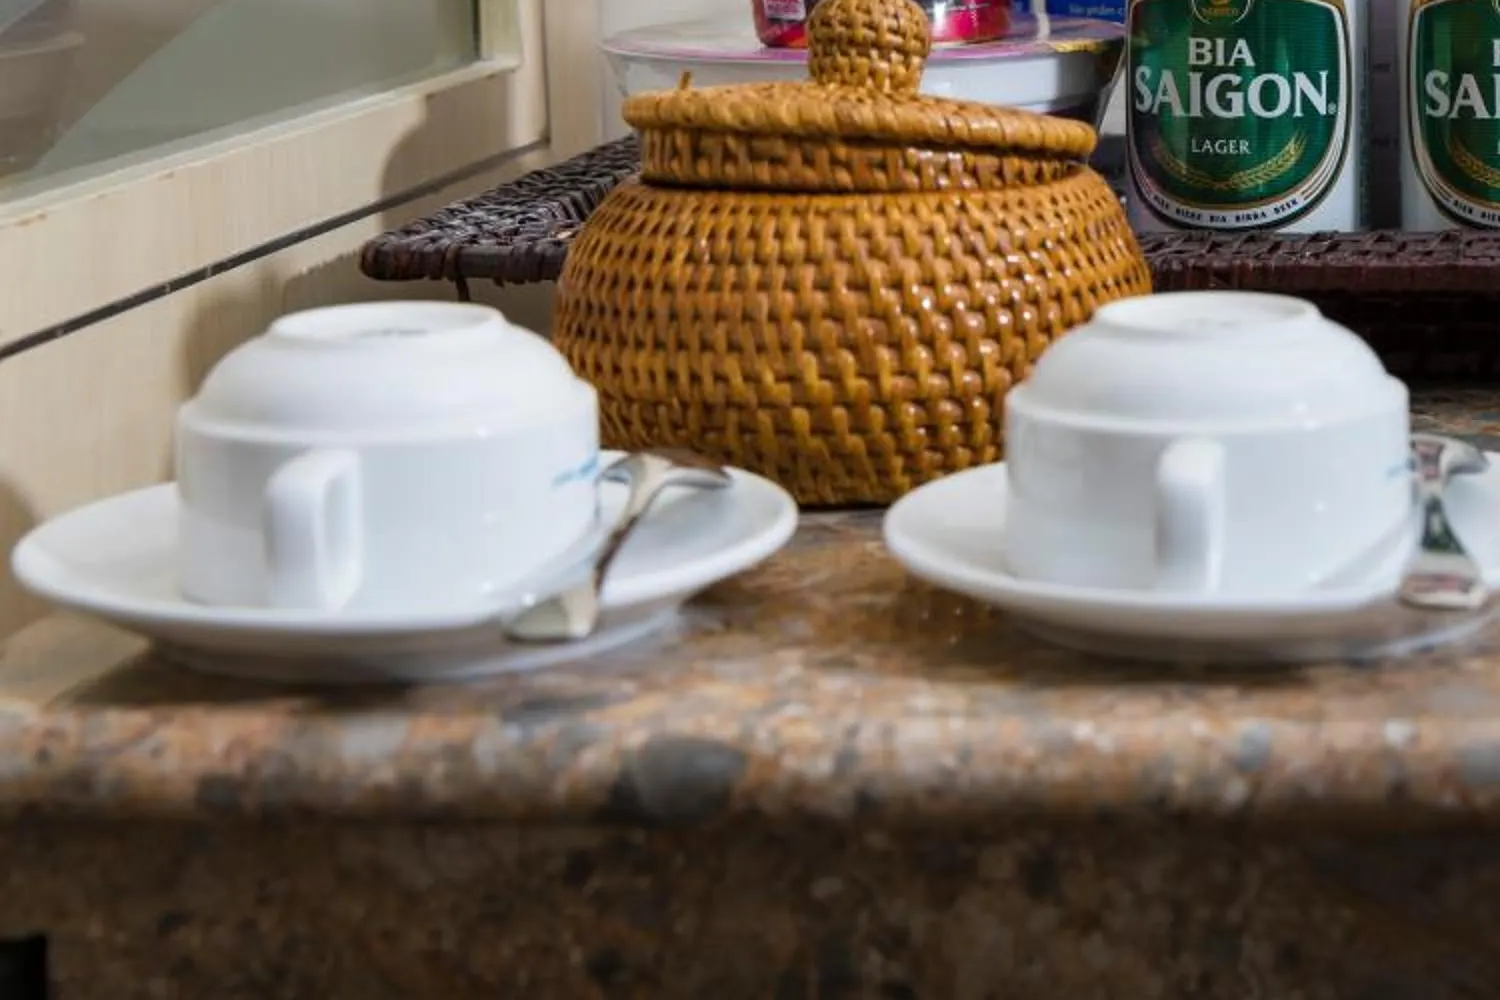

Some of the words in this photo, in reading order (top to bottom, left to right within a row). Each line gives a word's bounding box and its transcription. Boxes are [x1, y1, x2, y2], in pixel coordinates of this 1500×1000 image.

[1188, 37, 1256, 68] BIA
[1134, 65, 1330, 119] SAIGON
[1190, 138, 1250, 155] LAGER
